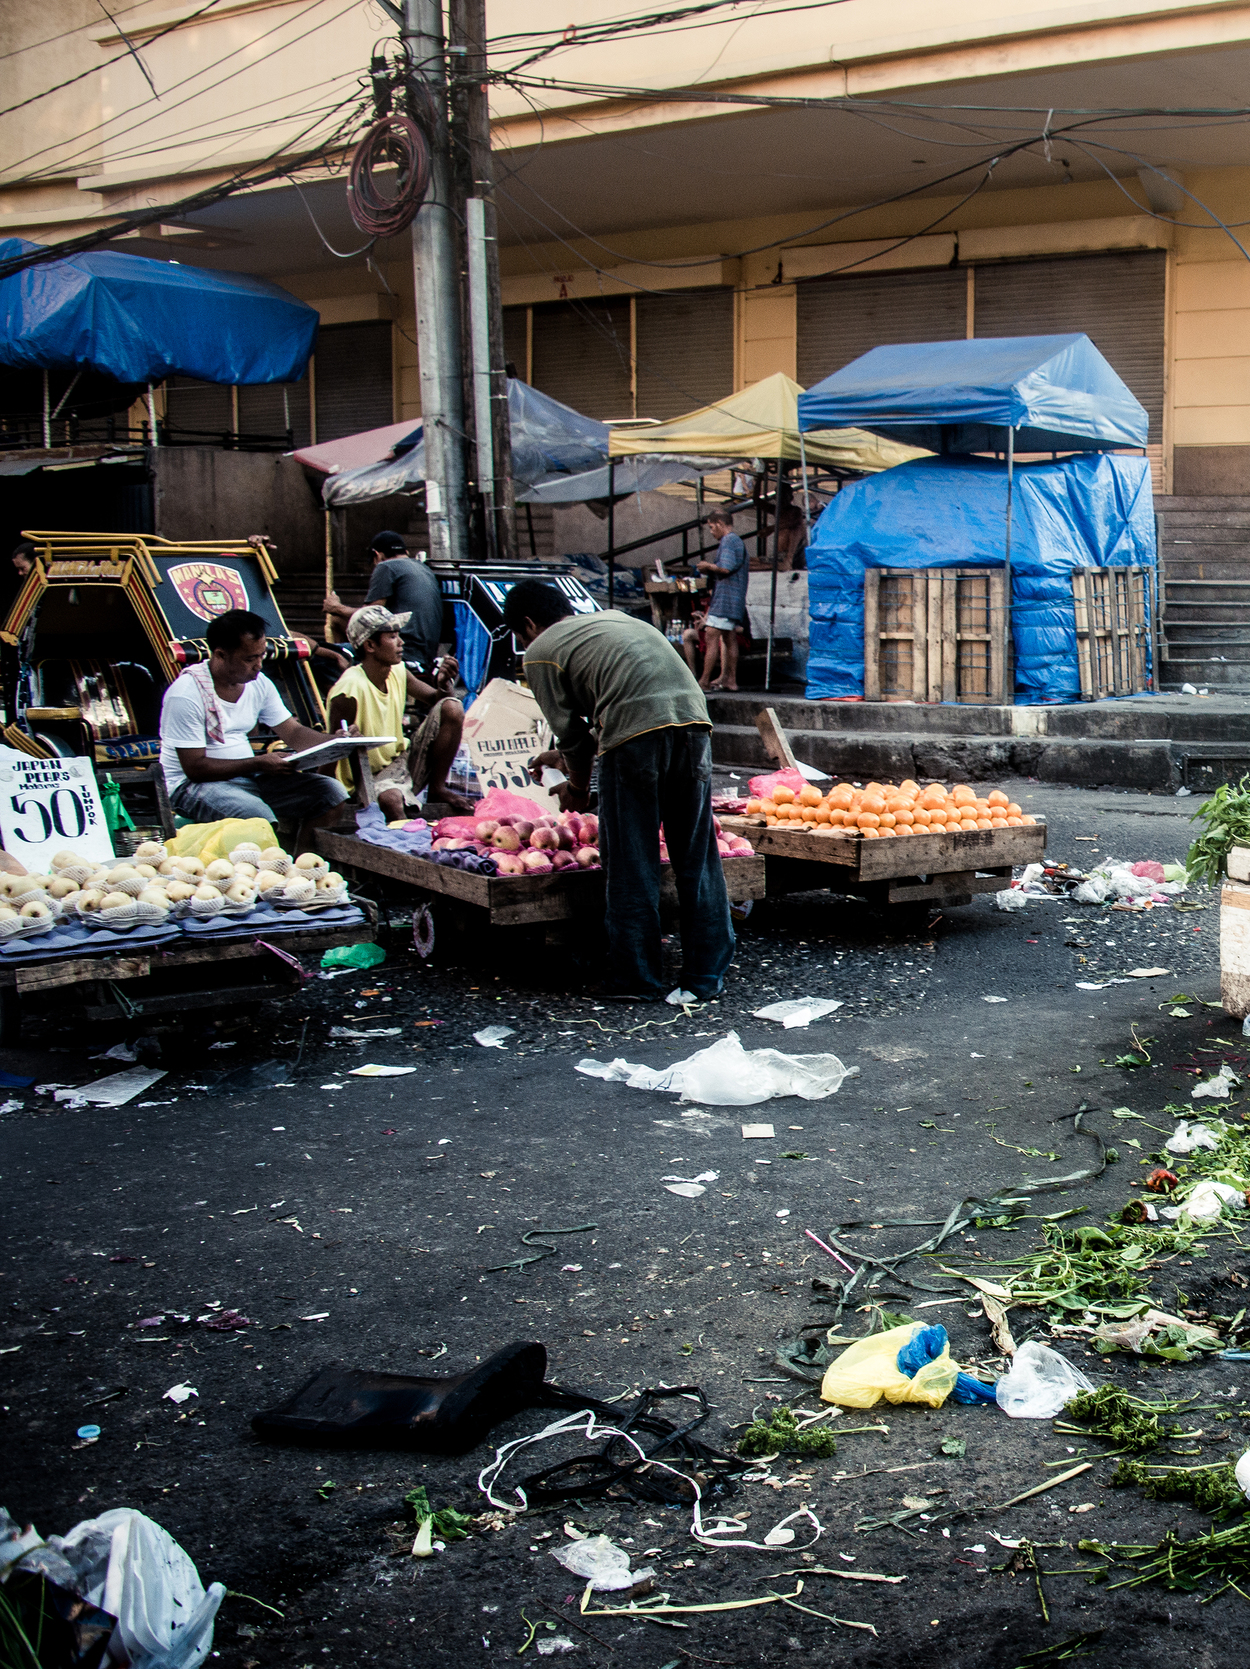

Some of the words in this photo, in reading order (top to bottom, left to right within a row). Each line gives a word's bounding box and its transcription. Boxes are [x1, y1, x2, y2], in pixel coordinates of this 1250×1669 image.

[477, 739, 506, 752] FUJI
[12, 760, 62, 772] JAPAN
[24, 771, 71, 783] PEARS
